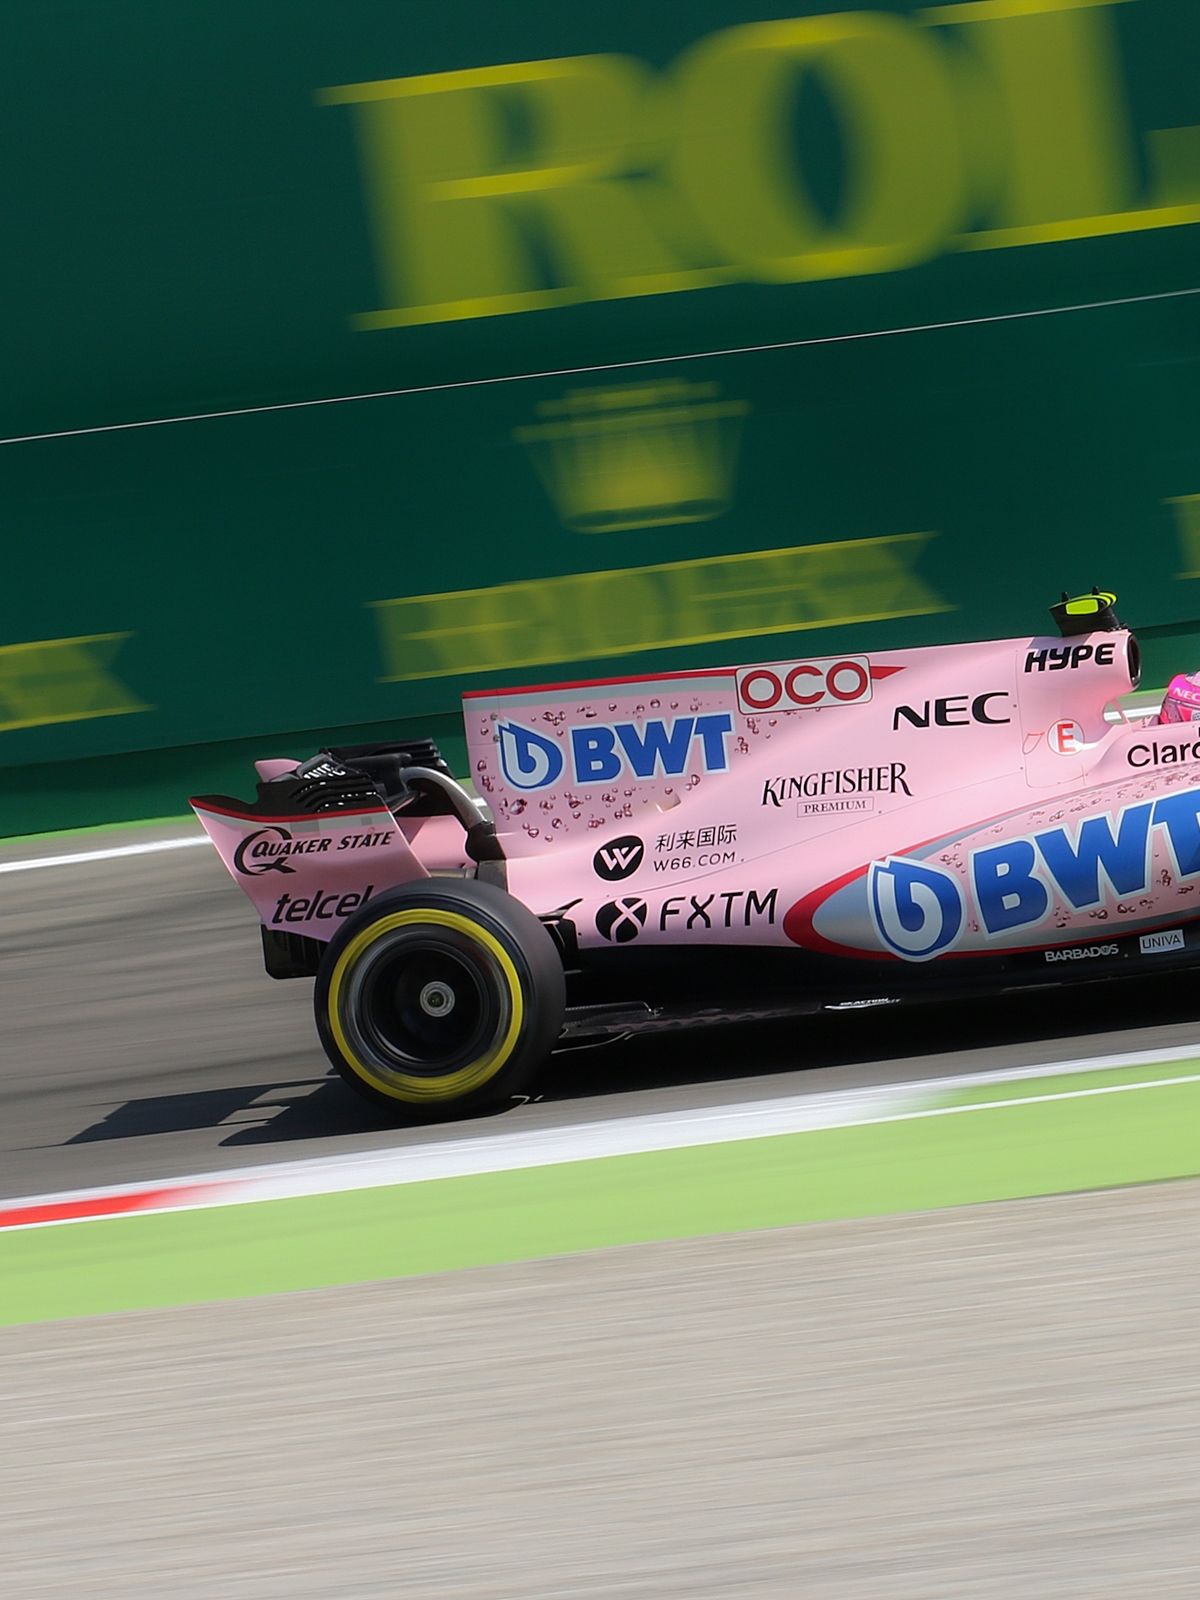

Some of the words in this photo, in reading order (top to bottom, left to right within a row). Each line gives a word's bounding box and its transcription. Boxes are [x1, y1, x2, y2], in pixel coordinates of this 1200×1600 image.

[1024, 643, 1116, 673] HYPE
[740, 661, 869, 709] OCO
[893, 691, 1011, 731] NEC
[570, 713, 735, 786] BWT
[1057, 723, 1077, 752] E
[761, 762, 915, 808] KINGFISHER
[803, 800, 867, 814] PREMIUM
[252, 837, 332, 858] QUAKER
[338, 830, 396, 850] STATE
[654, 824, 738, 853] 利来国际
[653, 850, 736, 873] W66.COM
[272, 885, 374, 925] telcel
[659, 888, 779, 932] FXTM
[1045, 943, 1120, 963] BARBADOS
[1142, 932, 1182, 950] UNIVA
